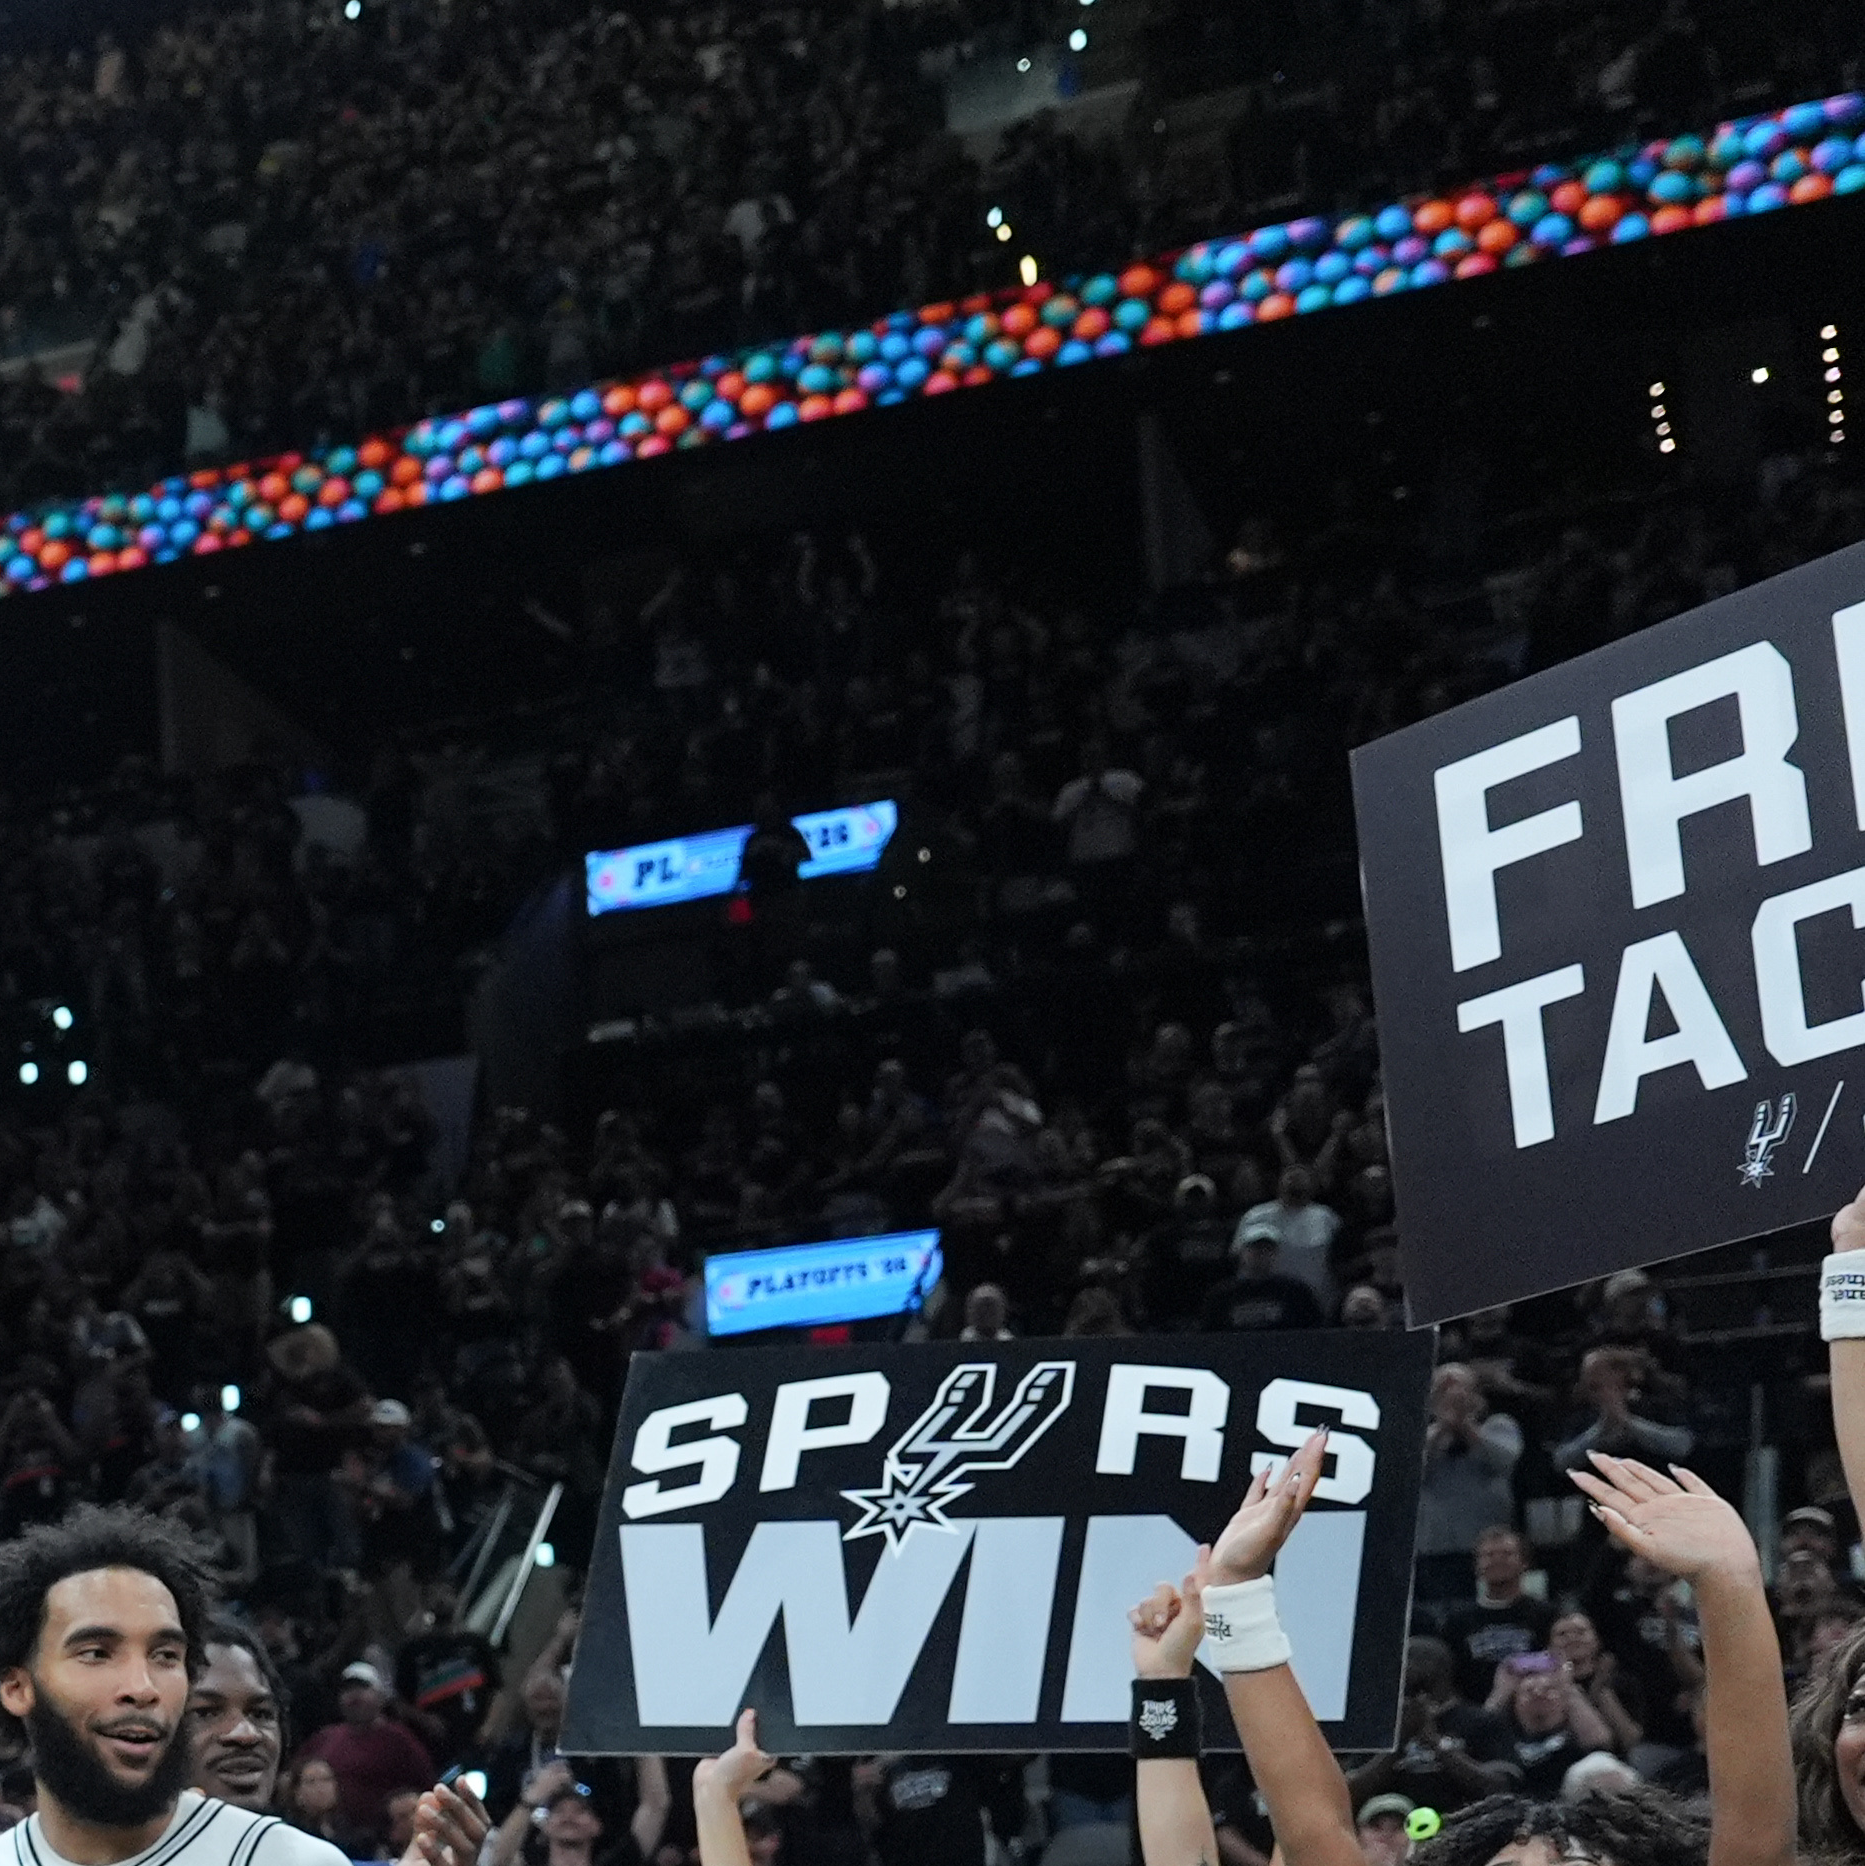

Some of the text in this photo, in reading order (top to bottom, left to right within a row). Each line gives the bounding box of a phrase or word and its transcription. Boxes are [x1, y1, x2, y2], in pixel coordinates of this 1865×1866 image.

[1457, 868, 1865, 1150] TAC
[622, 1361, 1381, 1556] SPURS
[619, 1508, 1367, 1727] WIN
